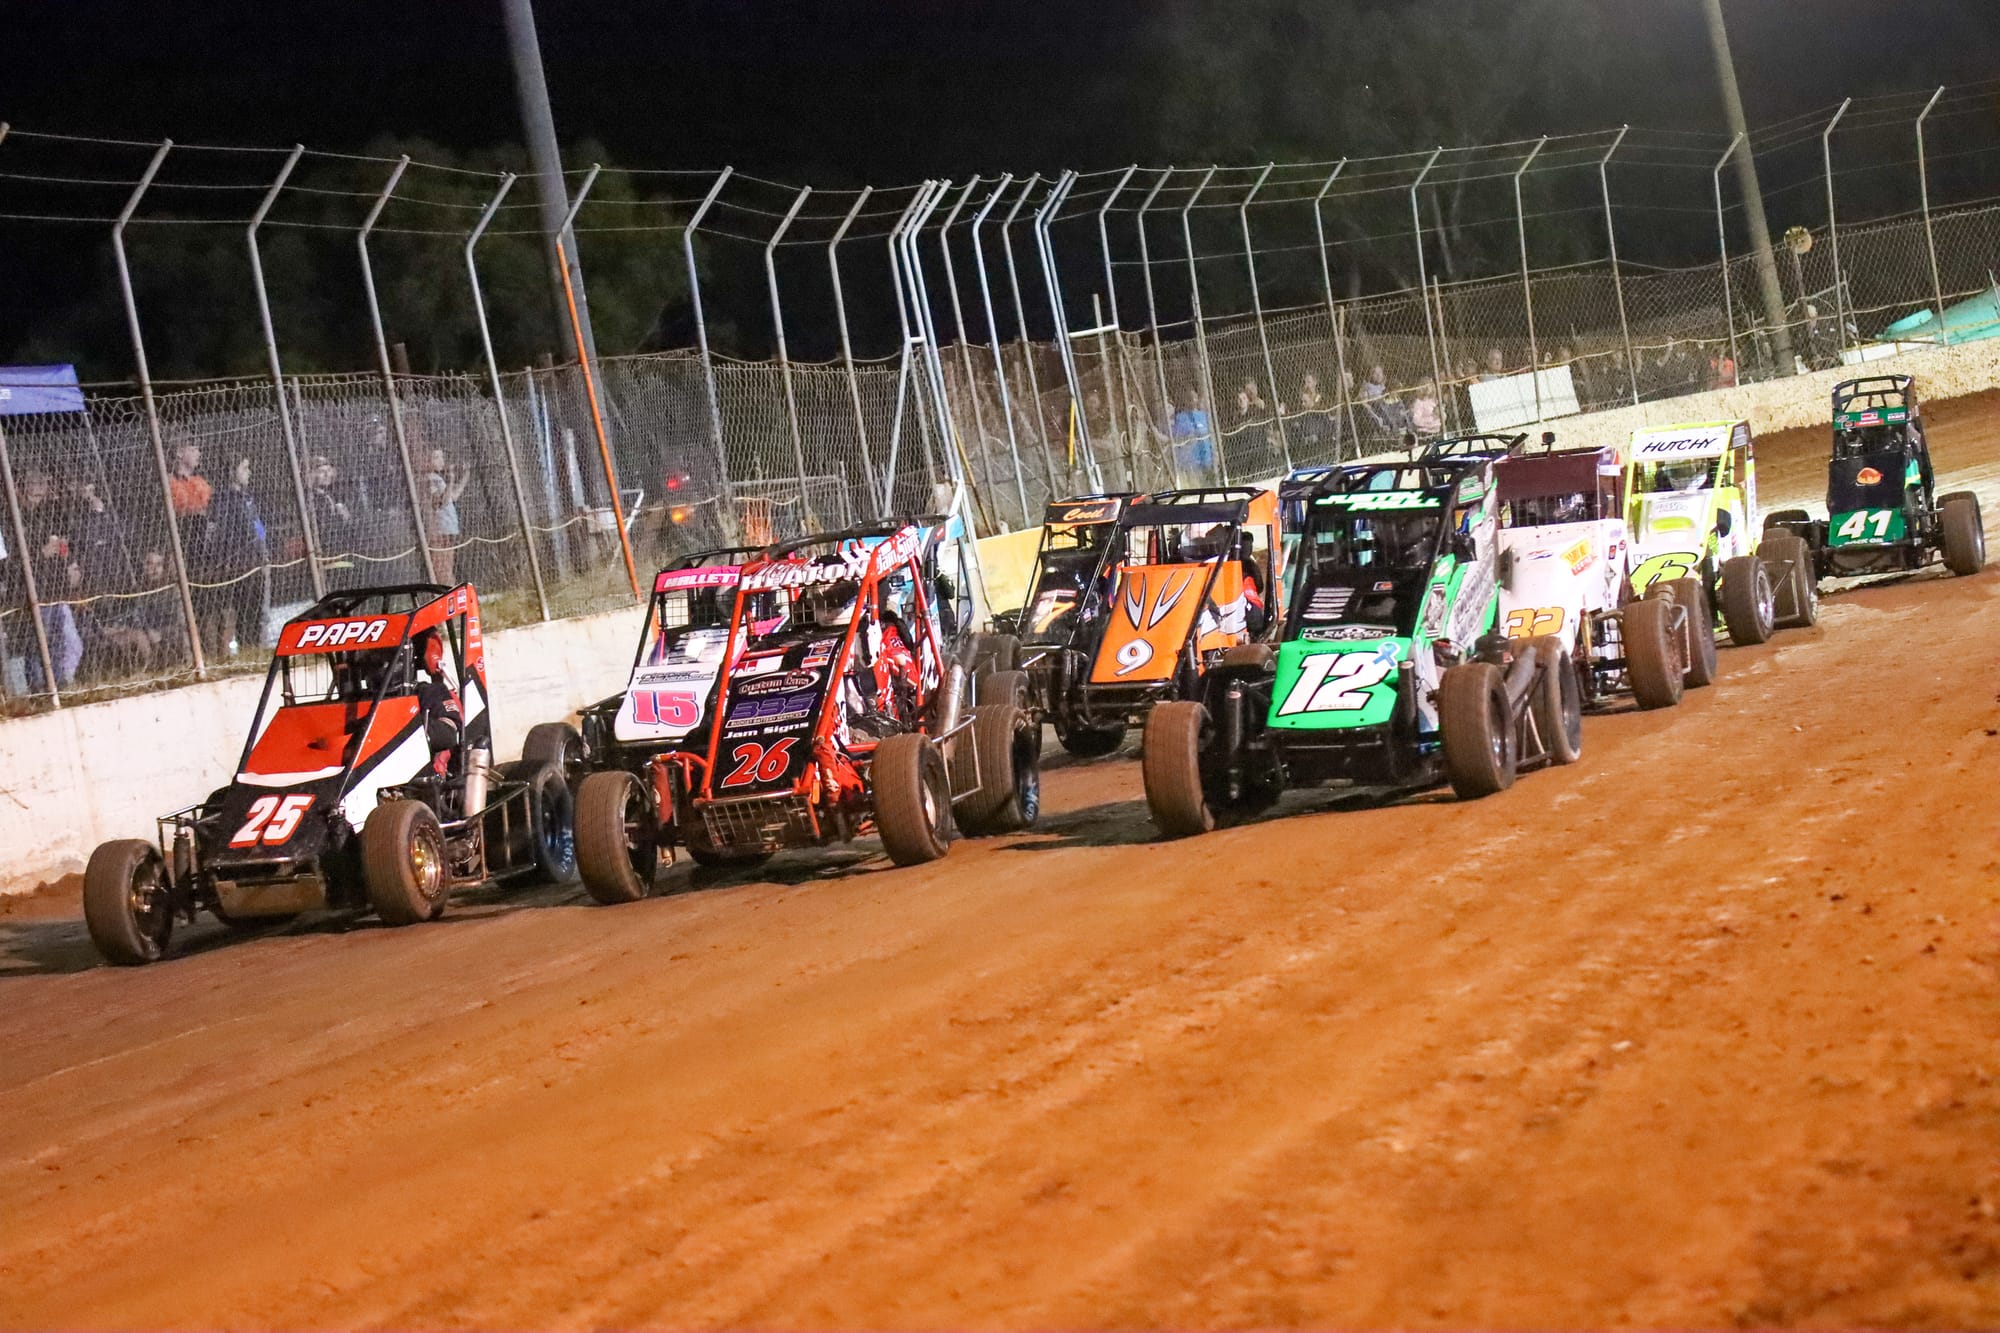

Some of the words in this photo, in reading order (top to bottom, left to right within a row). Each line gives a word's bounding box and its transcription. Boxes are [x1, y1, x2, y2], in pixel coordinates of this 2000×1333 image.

[1642, 438, 1718, 453] HUTCHY
[1837, 510, 1893, 539] 41
[739, 560, 868, 591] HEATON
[296, 619, 389, 649] PAPA
[1114, 638, 1154, 678] 9
[1276, 650, 1392, 718] 12
[632, 690, 699, 728] 15
[723, 730, 758, 740] Jam
[763, 721, 809, 735] Signs
[720, 737, 801, 788] 26
[228, 794, 316, 848] 25
